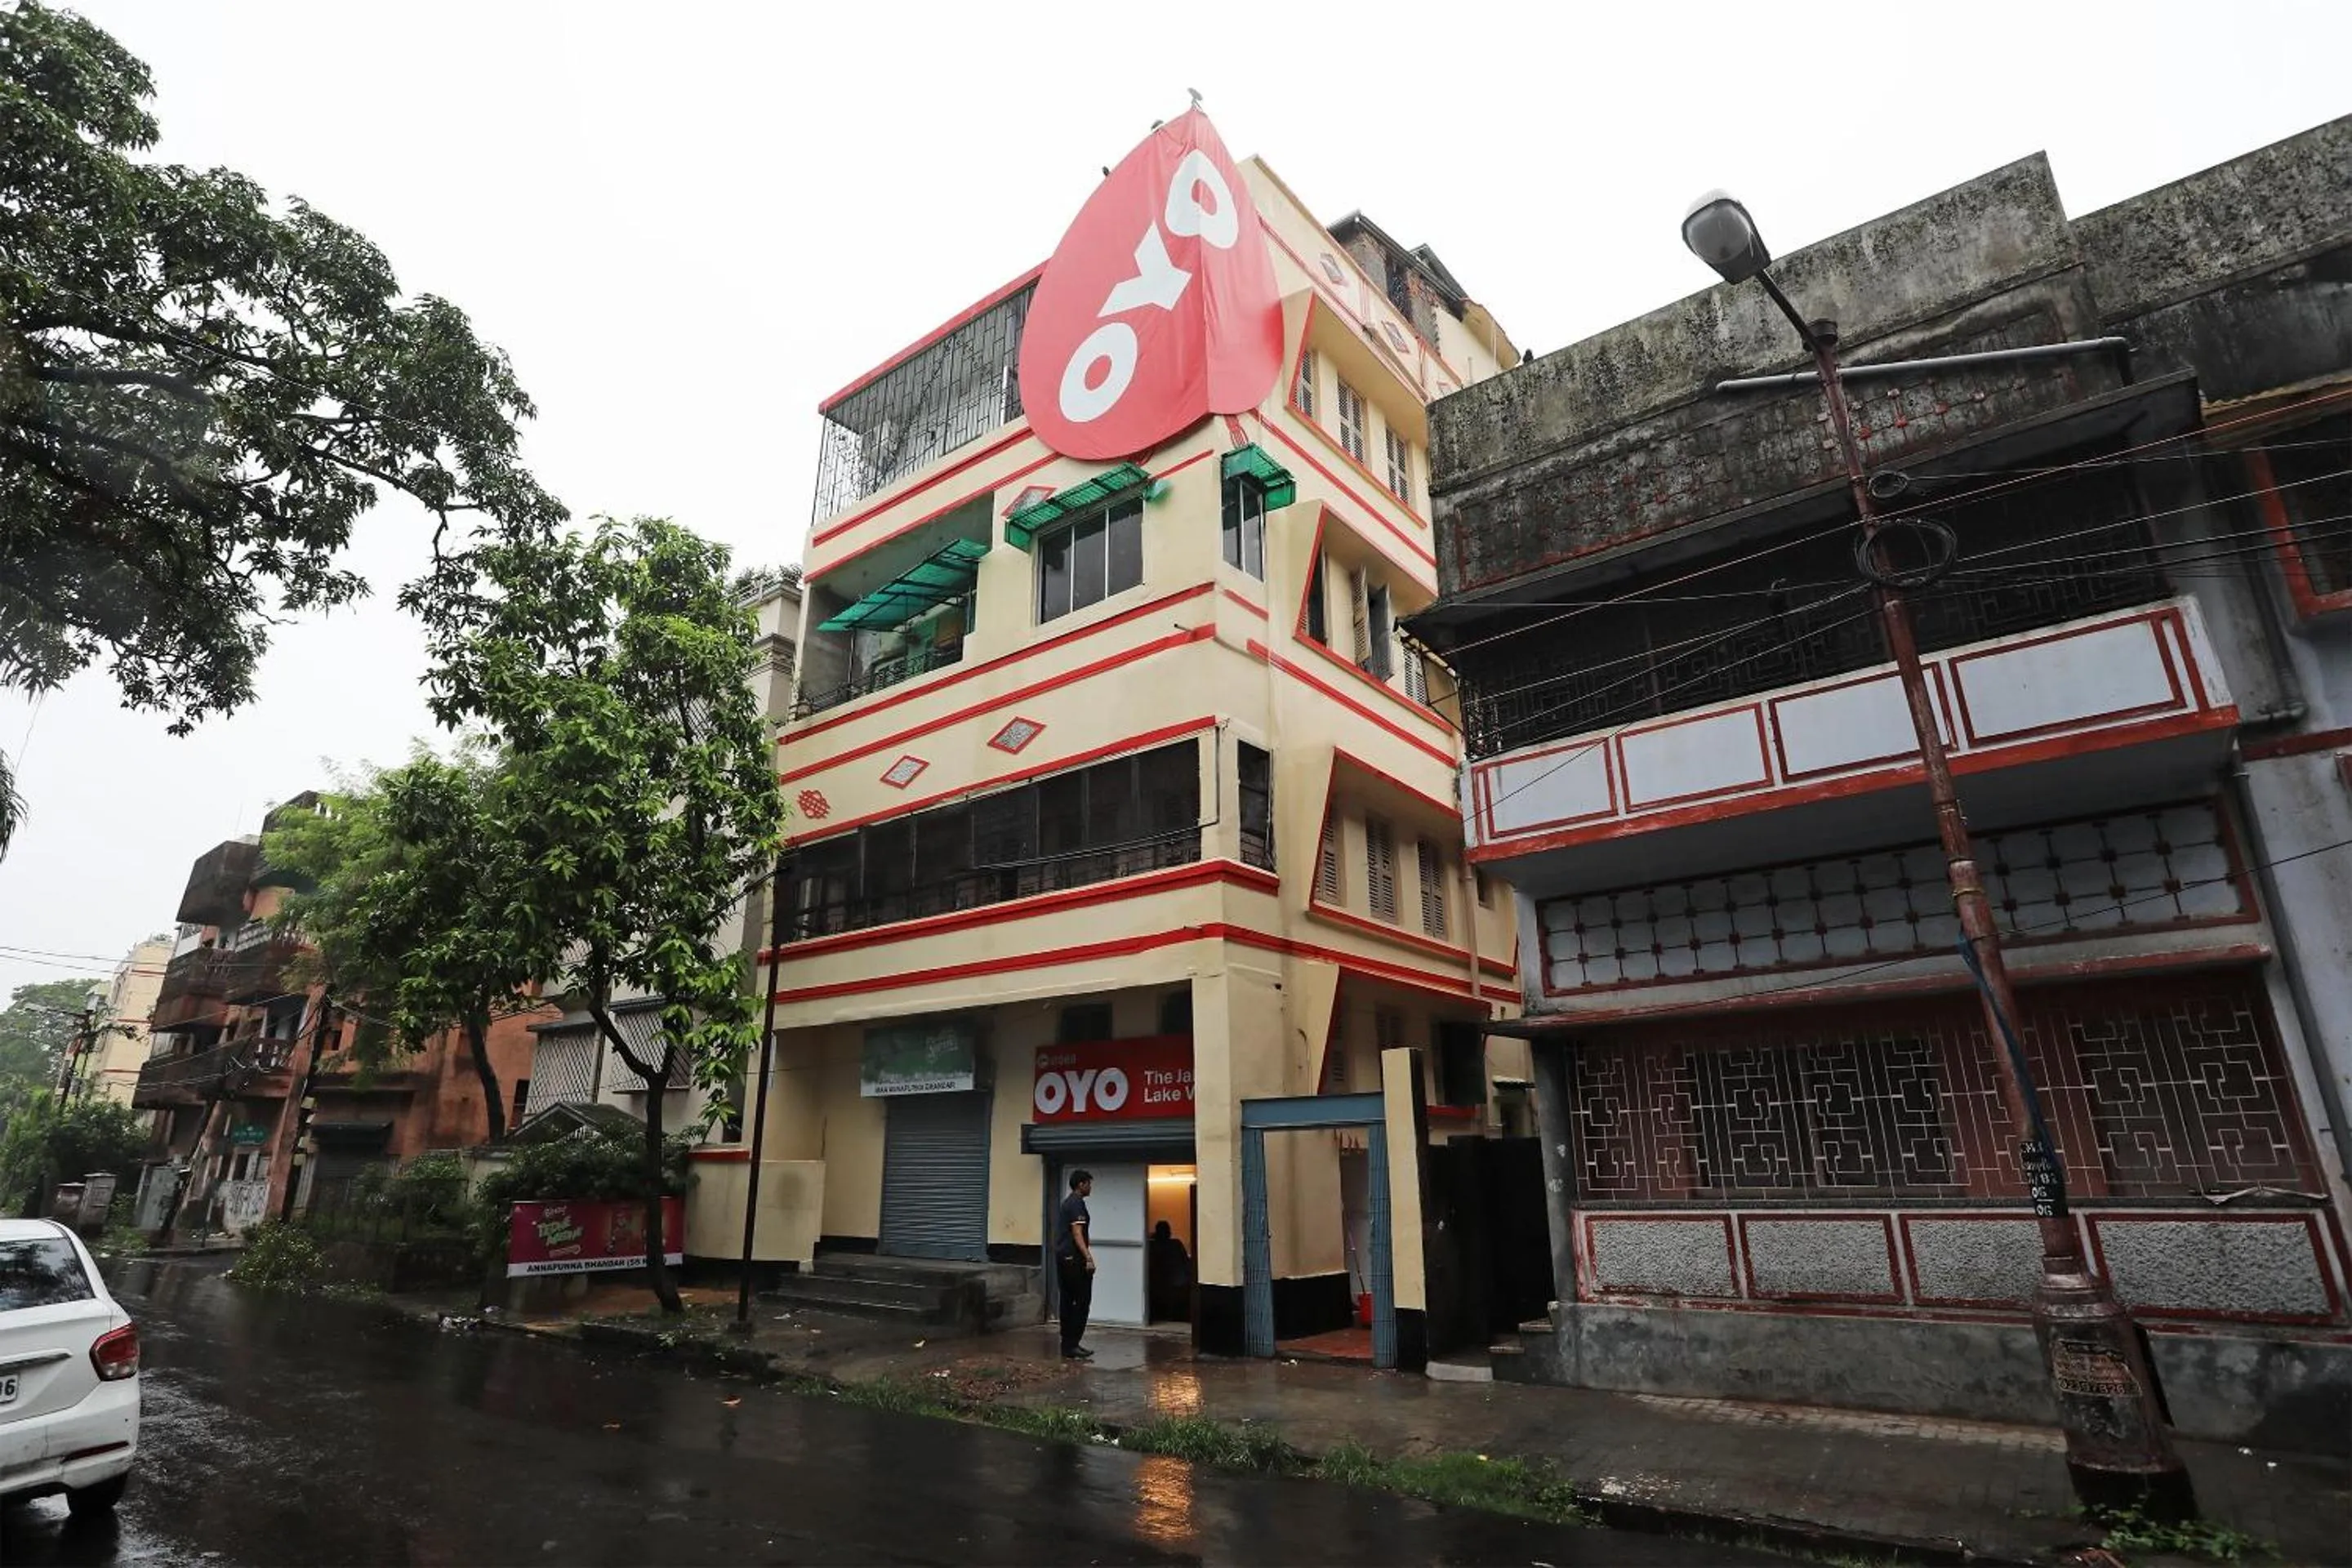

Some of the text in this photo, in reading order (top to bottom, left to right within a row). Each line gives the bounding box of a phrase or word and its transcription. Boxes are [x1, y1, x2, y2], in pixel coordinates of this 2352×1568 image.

[1059, 148, 1238, 423] OYO
[1143, 1068, 1194, 1085] The Ja
[1034, 1067, 1129, 1115] OYO
[1143, 1086, 1182, 1102] Lake
[0, 1379, 16, 1396] 6
